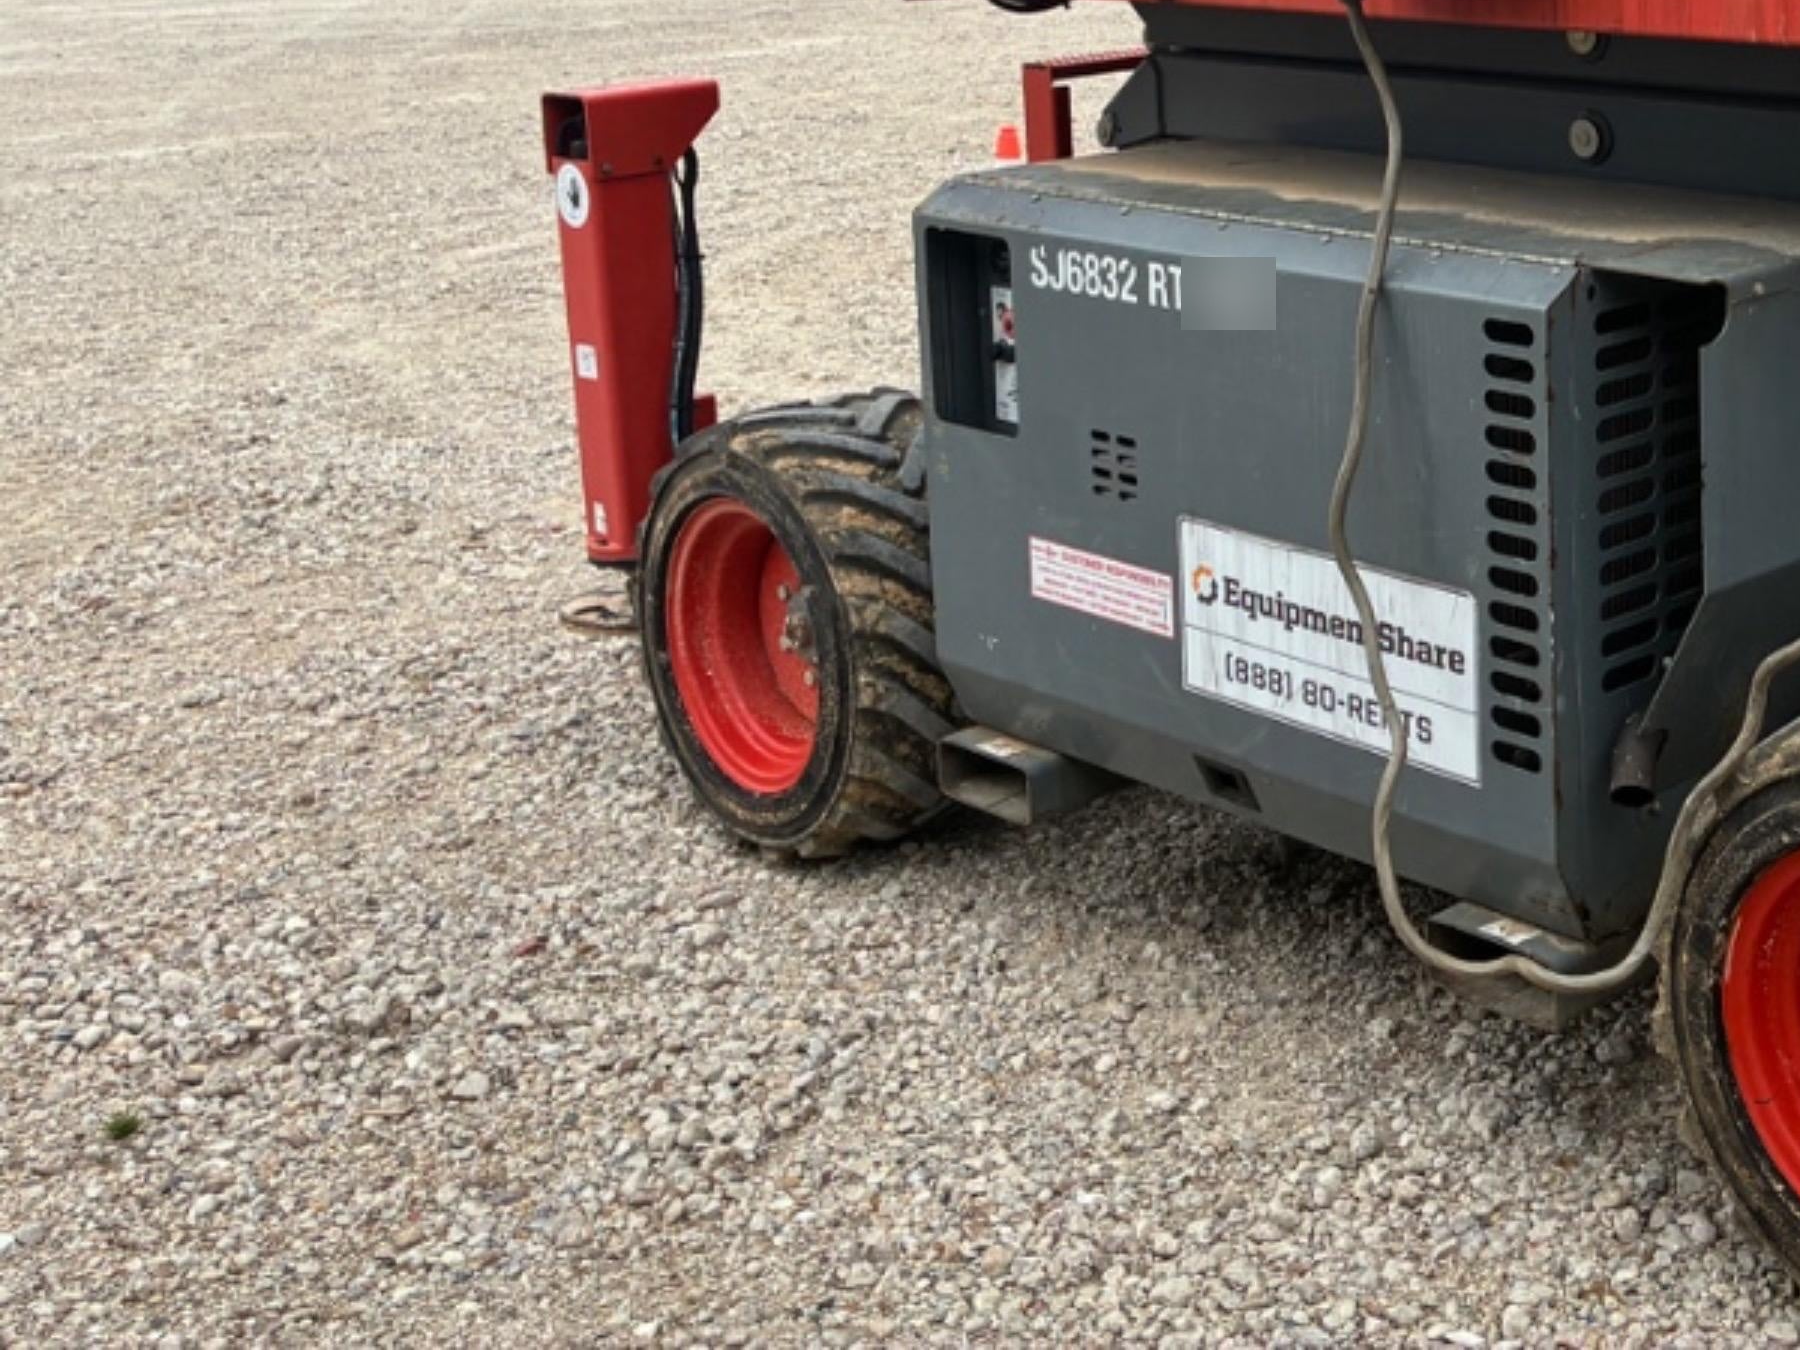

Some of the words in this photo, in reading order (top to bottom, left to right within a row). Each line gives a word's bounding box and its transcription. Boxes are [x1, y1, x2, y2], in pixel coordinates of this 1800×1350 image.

[1030, 244, 1138, 304] SJ6832
[1222, 576, 1466, 676] EquipmenShare
[1226, 652, 1294, 701] (888)
[1302, 679, 1433, 745] 80-RETS
